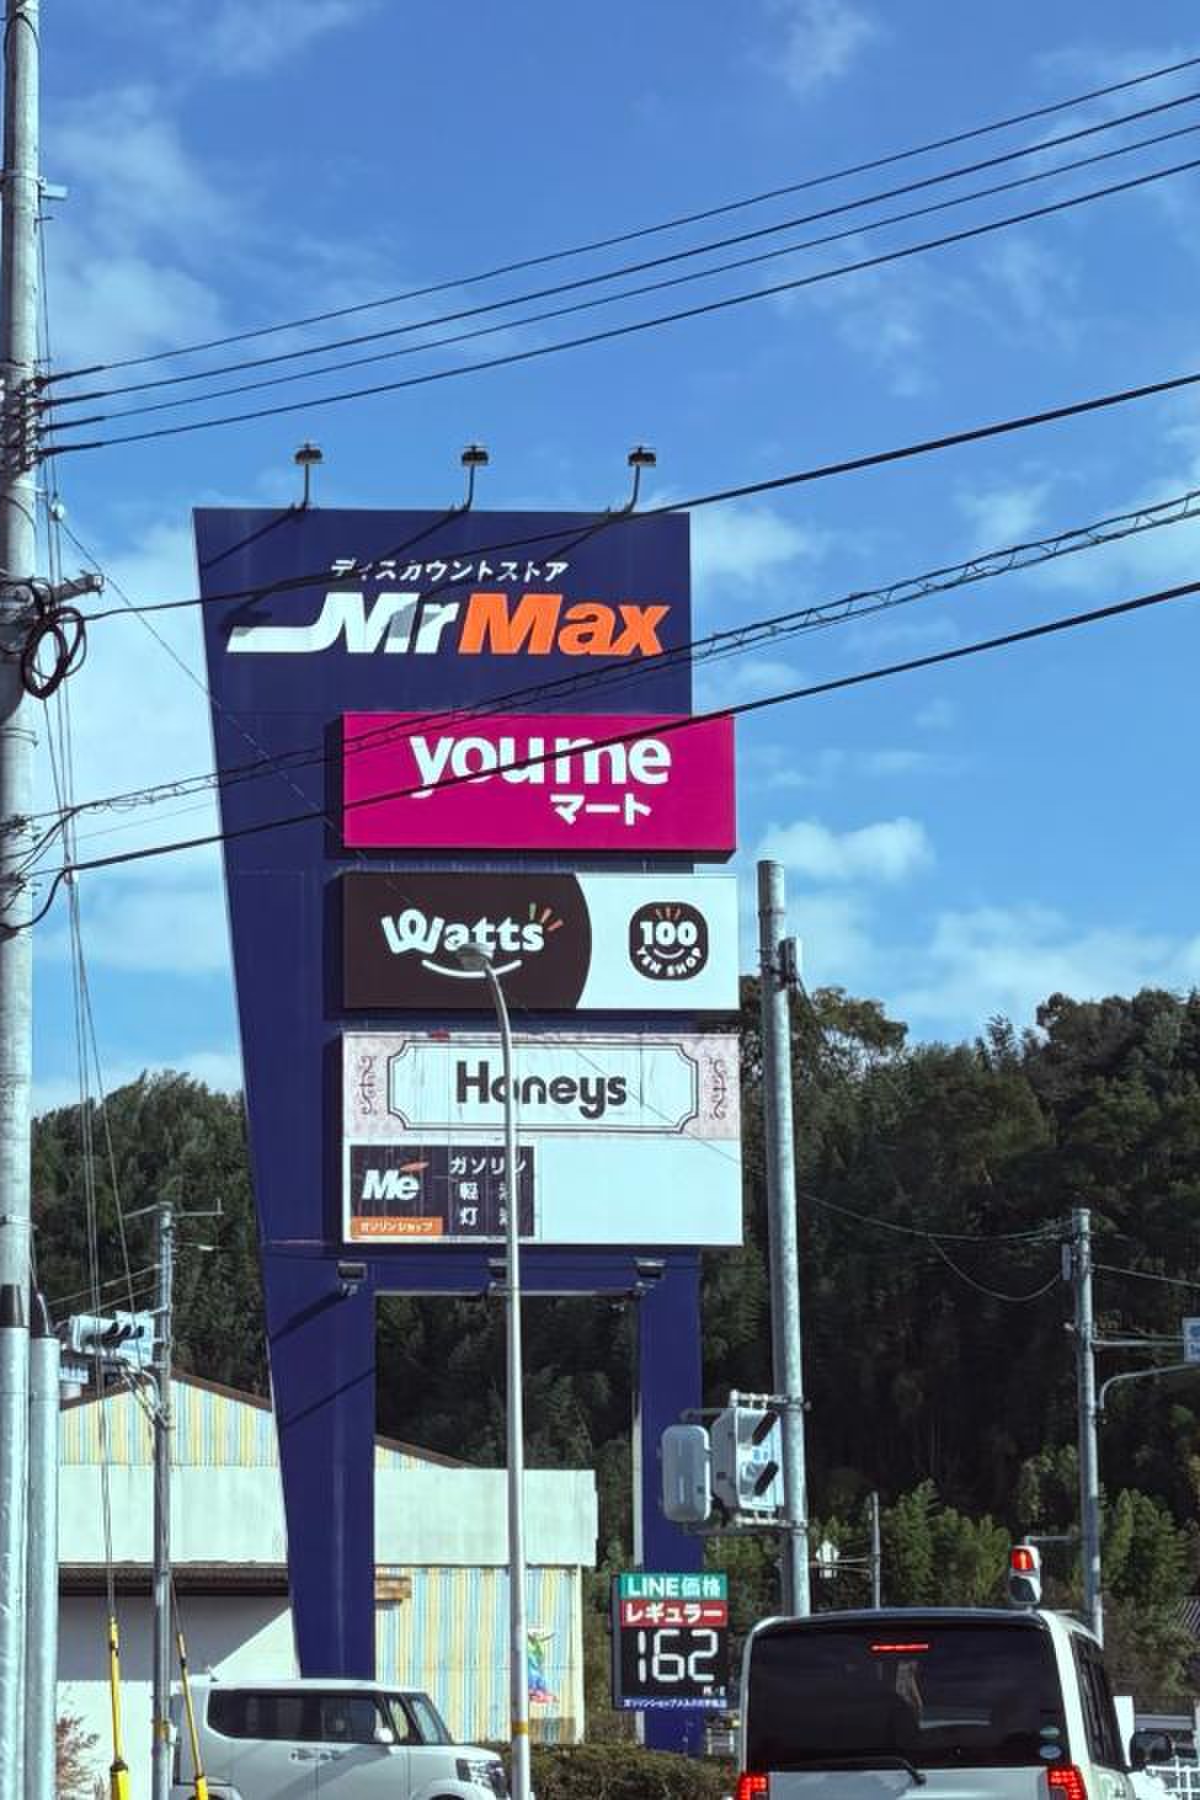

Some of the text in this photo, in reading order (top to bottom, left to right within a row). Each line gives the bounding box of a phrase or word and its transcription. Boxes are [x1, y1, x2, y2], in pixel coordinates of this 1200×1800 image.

[331, 558, 569, 582] ディスカウントストア
[409, 735, 672, 798] youme
[549, 793, 652, 826] マート
[381, 908, 545, 954] Watts
[639, 921, 698, 946] 100
[456, 1060, 627, 1120] Honeys
[627, 1577, 721, 1598] LINE価格
[625, 1602, 723, 1624] レギュラー
[637, 1629, 719, 1683] 162
